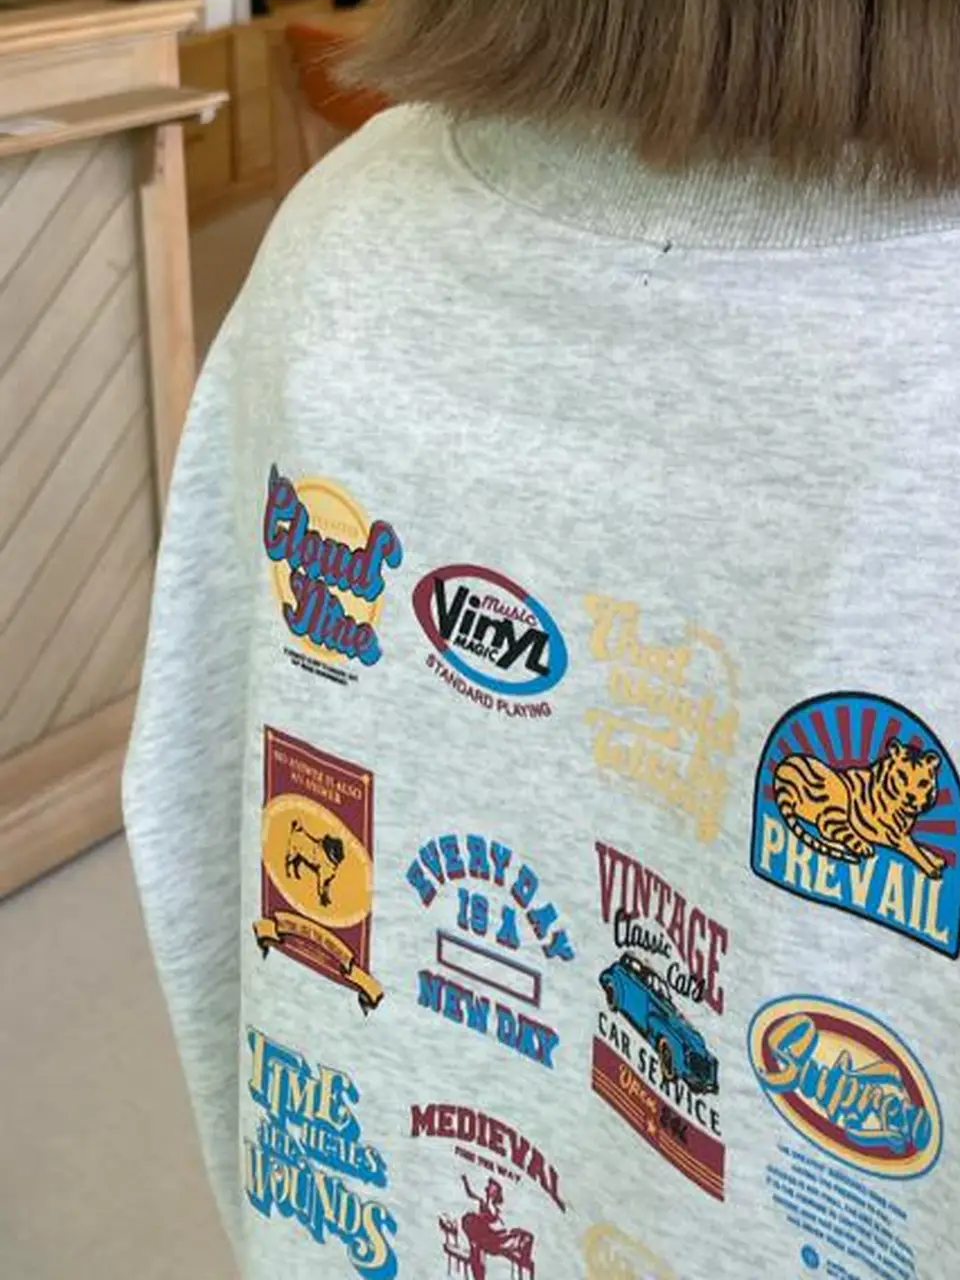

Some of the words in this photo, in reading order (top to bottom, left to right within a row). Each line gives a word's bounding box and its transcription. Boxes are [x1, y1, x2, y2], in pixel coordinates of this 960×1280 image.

[264, 463, 403, 601] Cloud
[283, 568, 382, 666] Nine
[453, 634, 500, 663] MAGIC
[425, 653, 494, 709] STANDARD
[496, 699, 552, 718] PLAYING
[406, 833, 512, 908] EVERY
[510, 863, 575, 961] DAY
[457, 887, 489, 936] IS
[496, 904, 520, 950] A
[595, 841, 729, 1016] VINTAGE
[760, 813, 949, 944] PREVAIL
[614, 907, 672, 959] Classic
[417, 969, 490, 1034] NEW
[495, 1001, 559, 1070] DAY
[247, 1024, 360, 1132] TIME
[598, 1011, 632, 1059] CAR
[638, 1047, 722, 1137] SERVICE
[410, 1104, 566, 1214] MEDIEVAL
